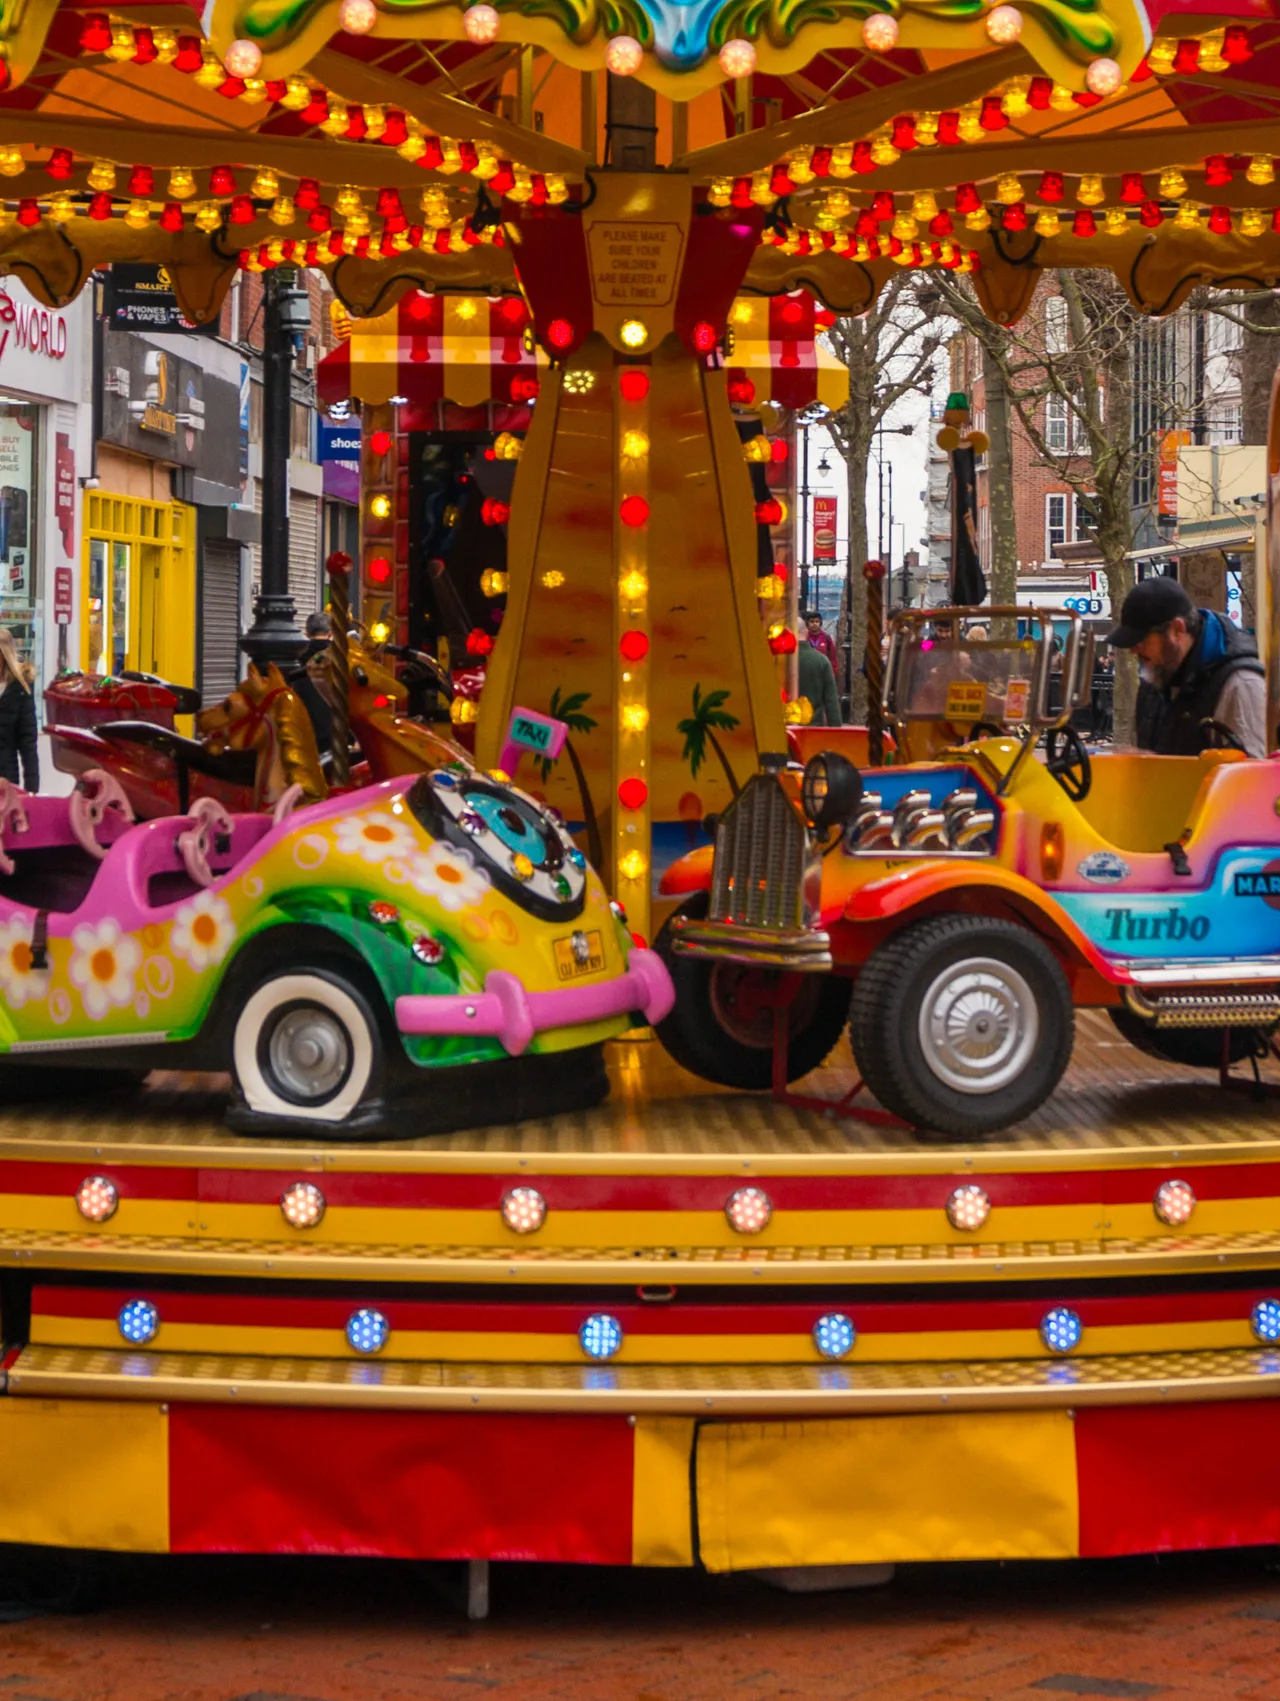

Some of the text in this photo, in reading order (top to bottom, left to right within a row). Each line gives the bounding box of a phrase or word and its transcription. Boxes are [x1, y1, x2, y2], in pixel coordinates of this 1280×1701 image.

[603, 231, 667, 242] PLEASE MAKE
[608, 245, 660, 255] SURE YOUR
[612, 260, 657, 269] CHILDREN
[599, 273, 616, 283] ARE
[657, 274, 667, 283] AT
[135, 282, 169, 291] SMART
[611, 287, 656, 298] ALL TIMES
[127, 305, 166, 314] PHONES
[137, 313, 167, 321] VAPES
[14, 301, 67, 360] WORLD
[1066, 601, 1099, 612] TSB
[517, 719, 549, 745] TAXI
[1105, 907, 1210, 941] Turbo
